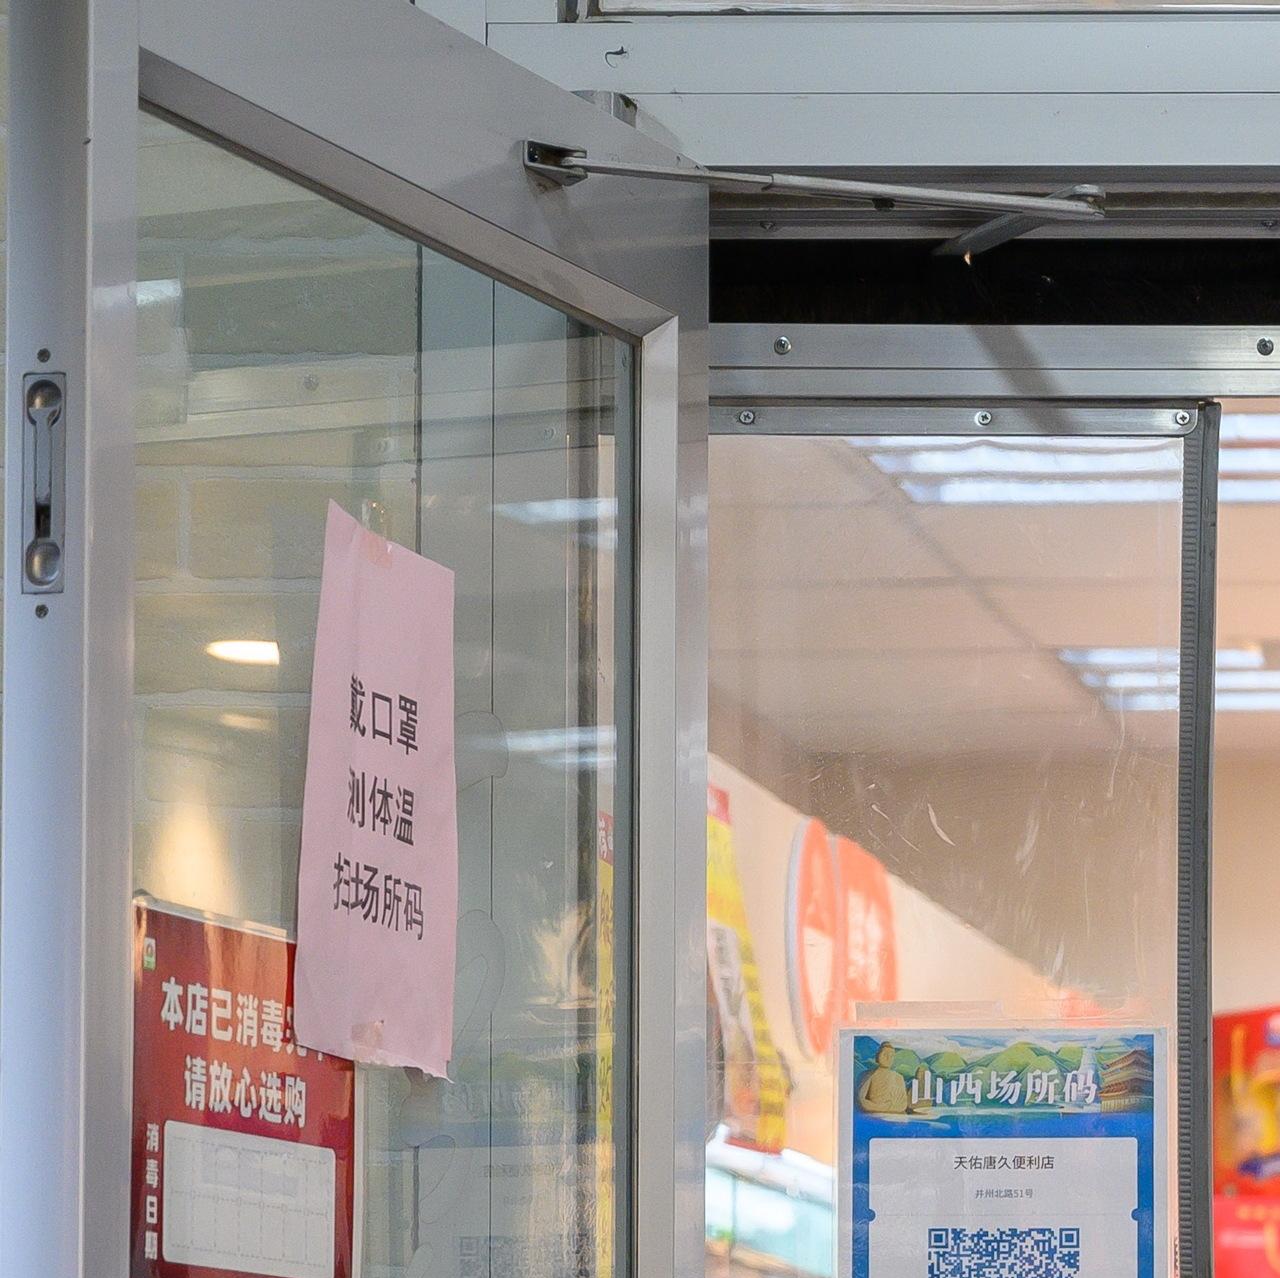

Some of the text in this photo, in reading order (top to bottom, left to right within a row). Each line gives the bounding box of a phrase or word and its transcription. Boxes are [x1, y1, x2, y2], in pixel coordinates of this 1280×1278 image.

[160, 975, 325, 1063] 本店已消毒
[183, 1054, 307, 1129] 请放心选购
[911, 1068, 1099, 1106] 山西场所码
[953, 1154, 1055, 1171] 天佑唐久便利店
